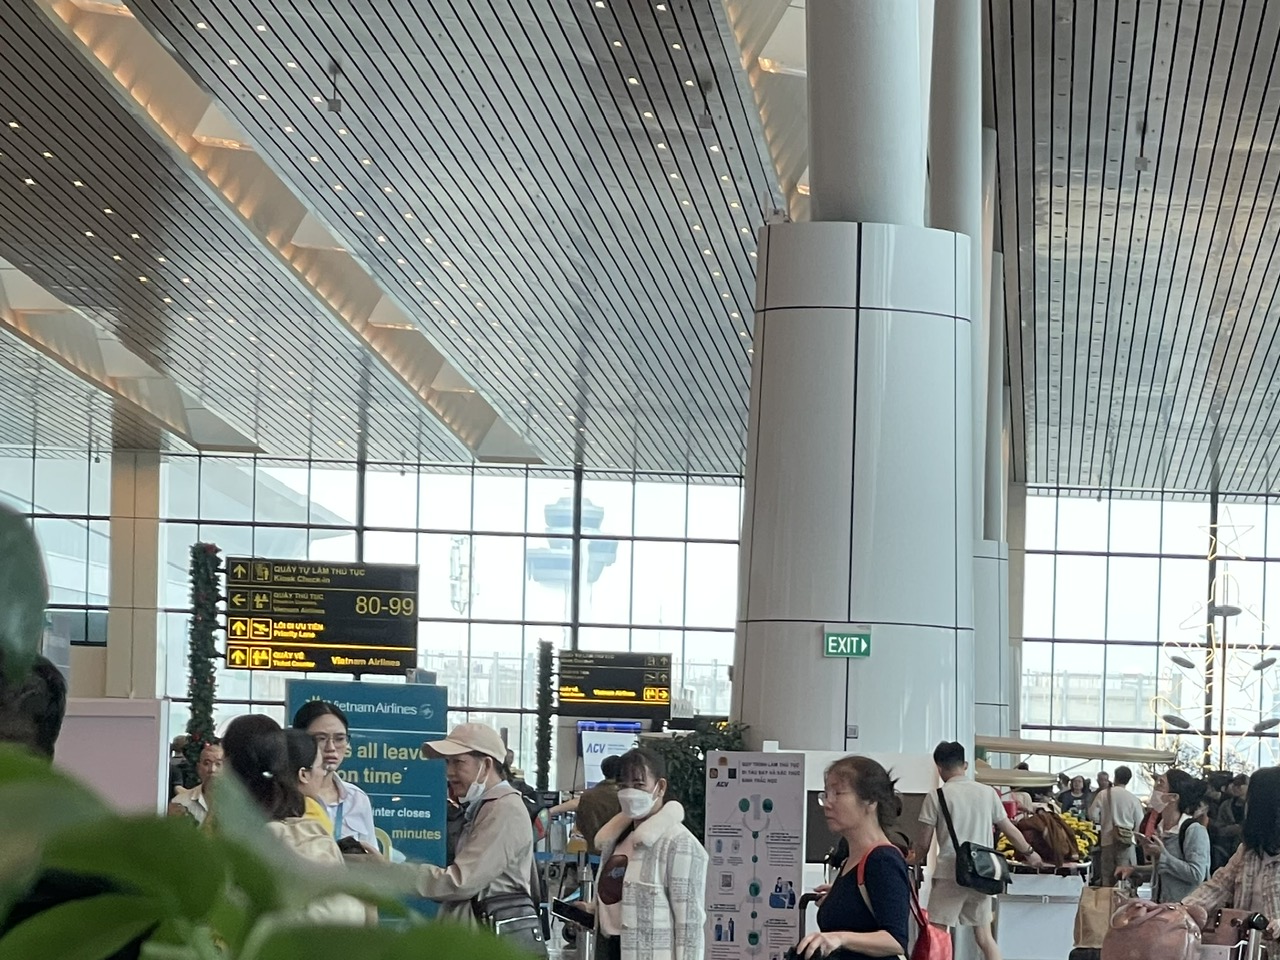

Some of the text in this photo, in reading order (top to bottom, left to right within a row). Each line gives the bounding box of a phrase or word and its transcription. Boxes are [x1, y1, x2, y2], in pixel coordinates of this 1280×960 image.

[355, 595, 415, 617] 80-99
[828, 636, 860, 654] EXIT
[376, 702, 418, 716] Airlines
[357, 742, 378, 759] all
[363, 767, 403, 785] time
[397, 807, 431, 819] closes
[391, 828, 442, 841] minutes
